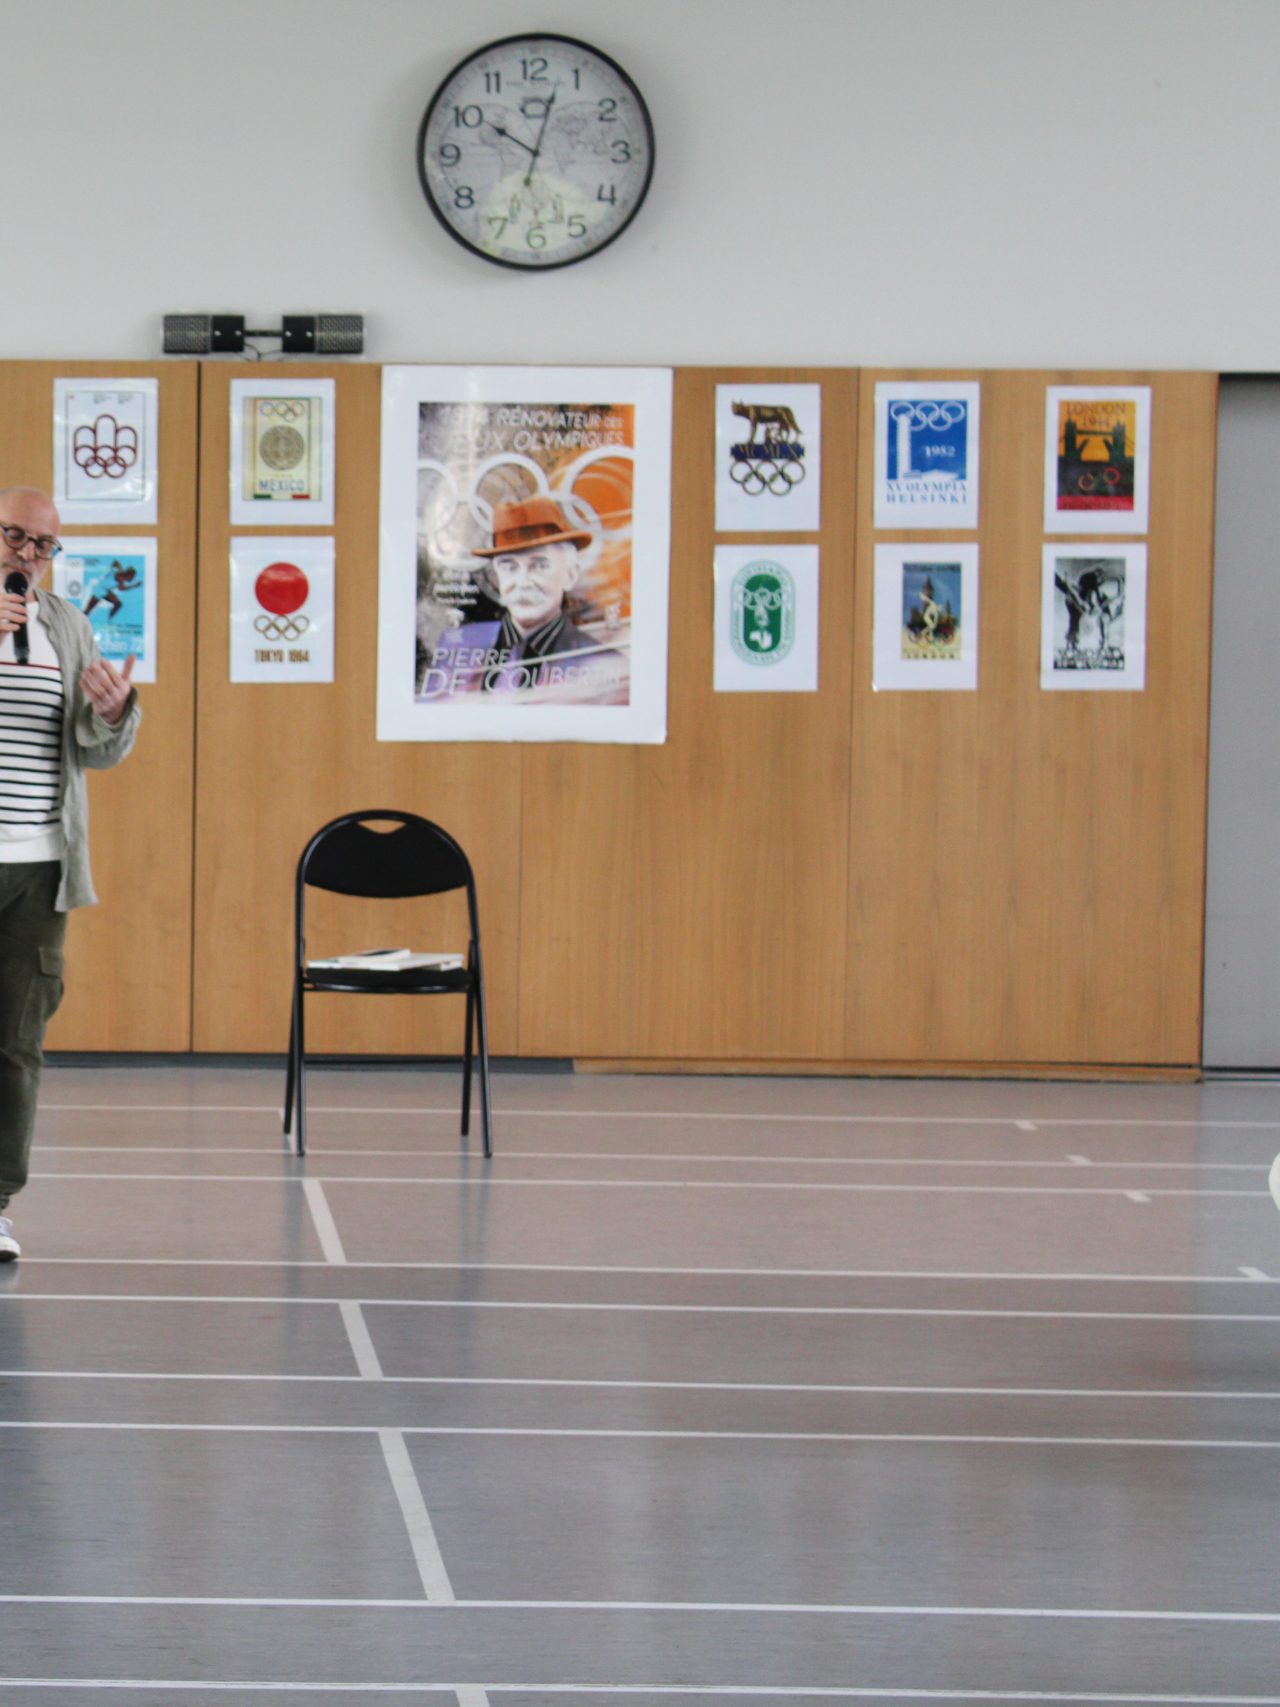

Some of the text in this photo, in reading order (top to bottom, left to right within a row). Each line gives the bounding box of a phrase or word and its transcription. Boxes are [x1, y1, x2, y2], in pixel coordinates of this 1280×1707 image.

[520, 57, 548, 82] 12
[571, 68, 581, 90] 1
[484, 71, 502, 94] 11
[453, 105, 484, 128] 10
[598, 98, 618, 122] 2
[440, 144, 461, 167] 9
[611, 140, 631, 164] 3
[454, 186, 475, 209] 8
[597, 184, 618, 206] 4
[487, 217, 509, 240] 7
[525, 226, 546, 250] 6
[567, 214, 587, 239] 5
[513, 430, 625, 451] OLYMPIQUES
[431, 648, 510, 667] PIERRE
[422, 668, 470, 698] DE
